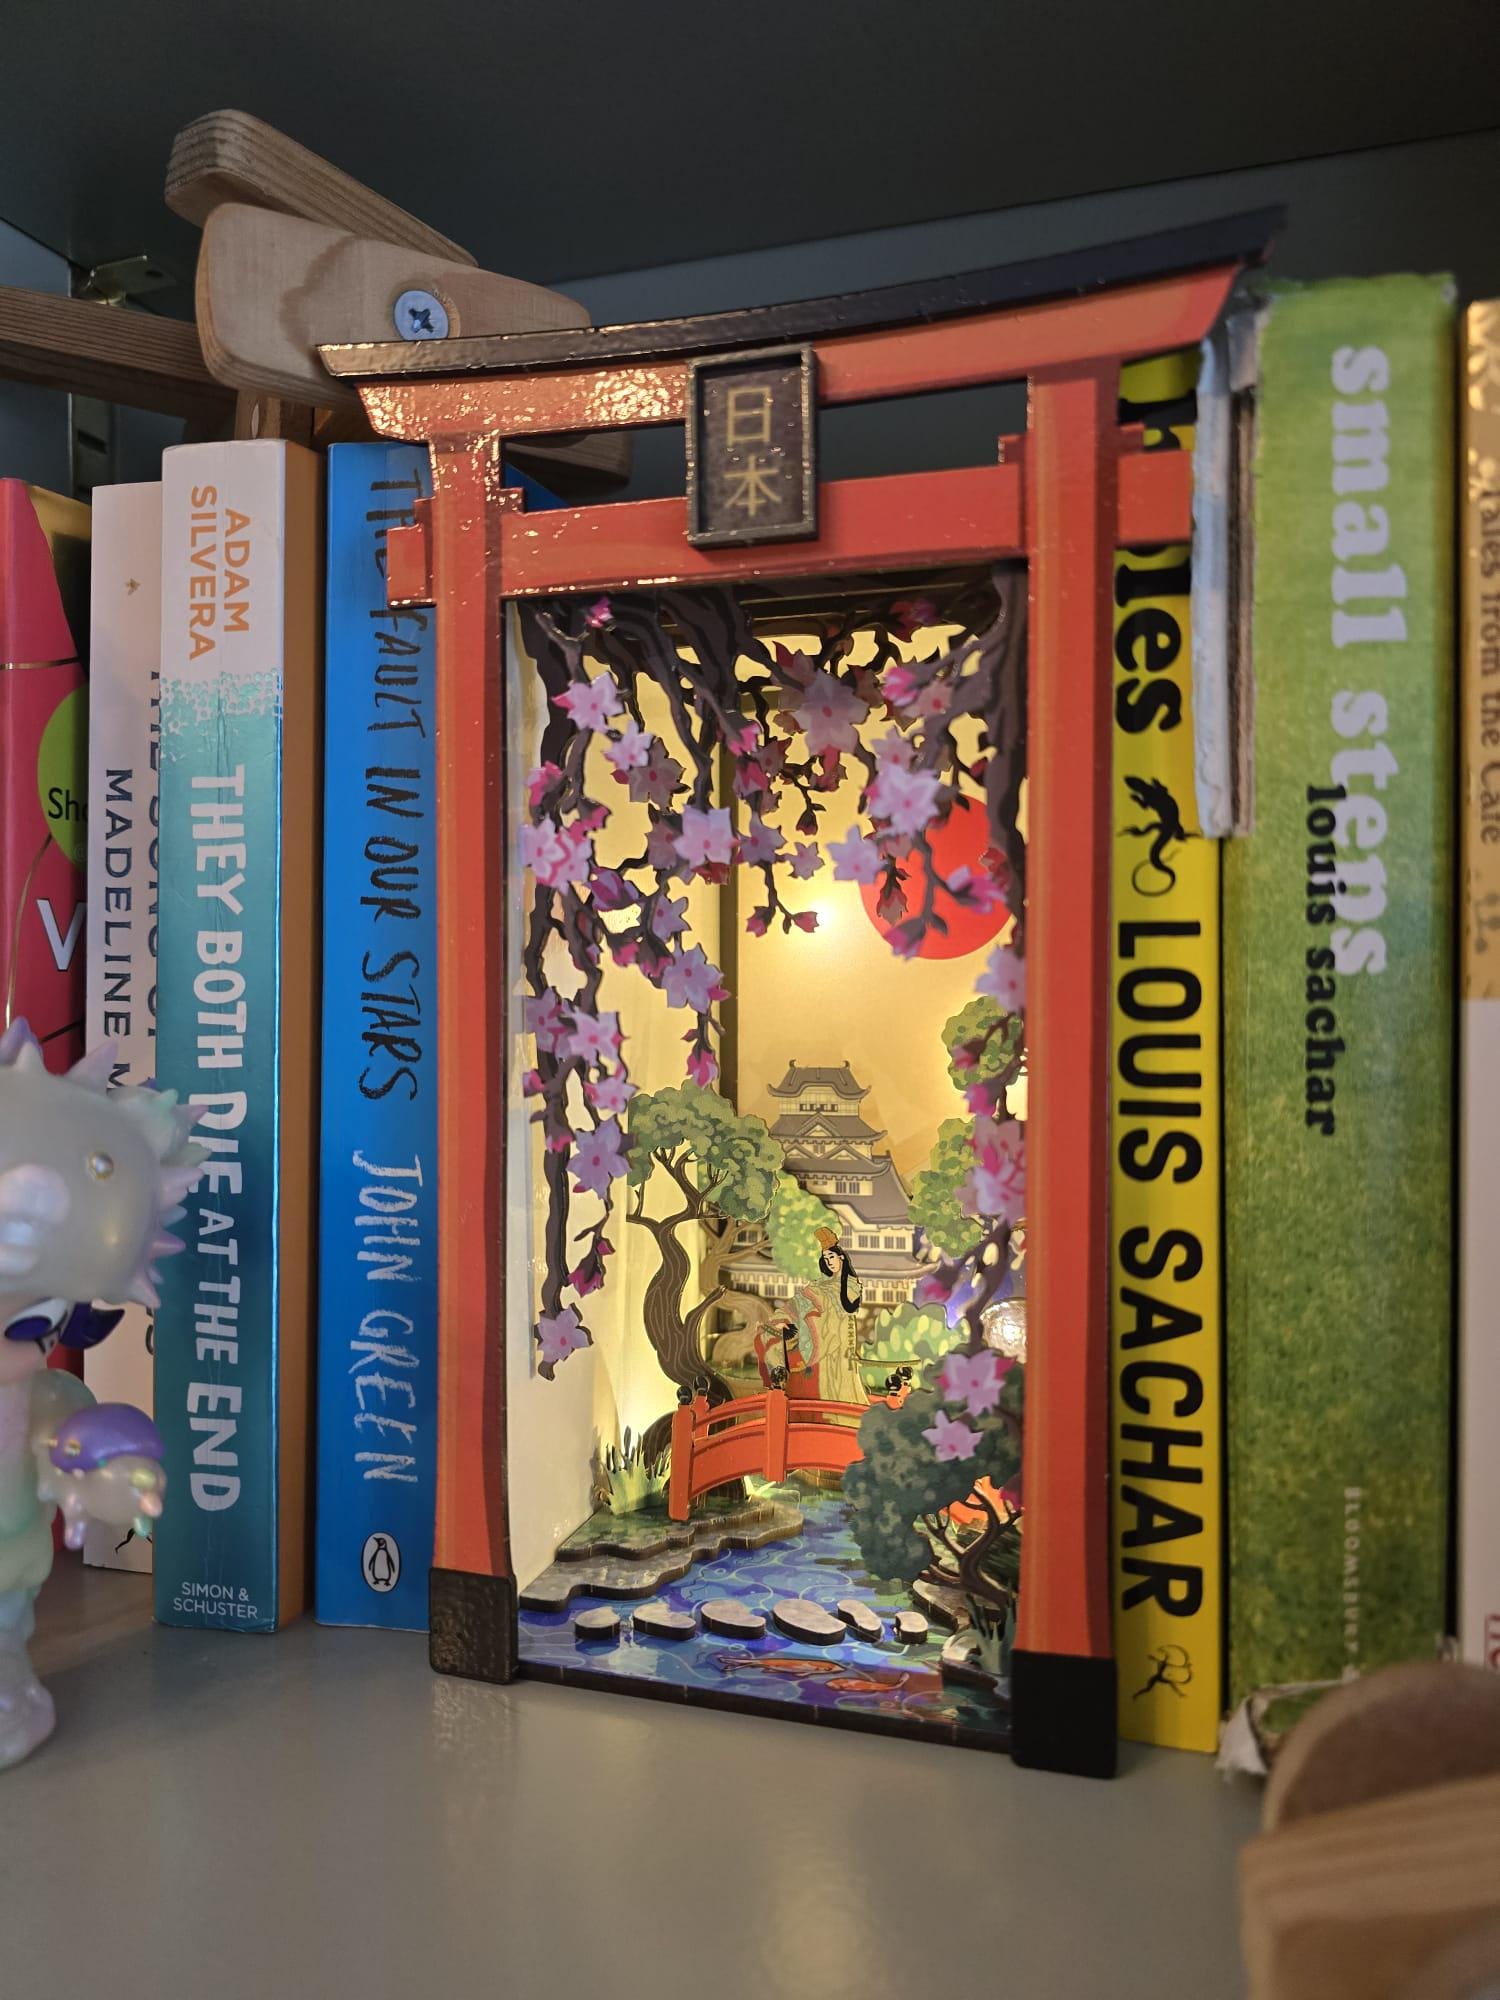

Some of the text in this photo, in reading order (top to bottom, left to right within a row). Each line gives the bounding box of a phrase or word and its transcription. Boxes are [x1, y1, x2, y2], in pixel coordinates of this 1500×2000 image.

[723, 384, 784, 518] 日本
[188, 485, 218, 661] SILVERA
[223, 507, 251, 633] ADAM
[367, 609, 428, 740] FAULT
[1330, 345, 1408, 977] small steps
[365, 765, 425, 819] IN
[103, 768, 133, 1038] MADELINE
[360, 834, 422, 922] OUR
[359, 951, 424, 1102] STARS
[1305, 783, 1347, 1137] louis sachar
[187, 764, 249, 1513] THEY BOTH DIE AT THE END
[348, 1149, 425, 1484] JOHN GREEN
[1117, 920, 1204, 1618] LOUIS SACHAR
[173, 1597, 259, 1620] SCHUSTER
[181, 1581, 250, 1602] SIMON &
[1343, 1486, 1361, 1654] BLOOMSBURY
